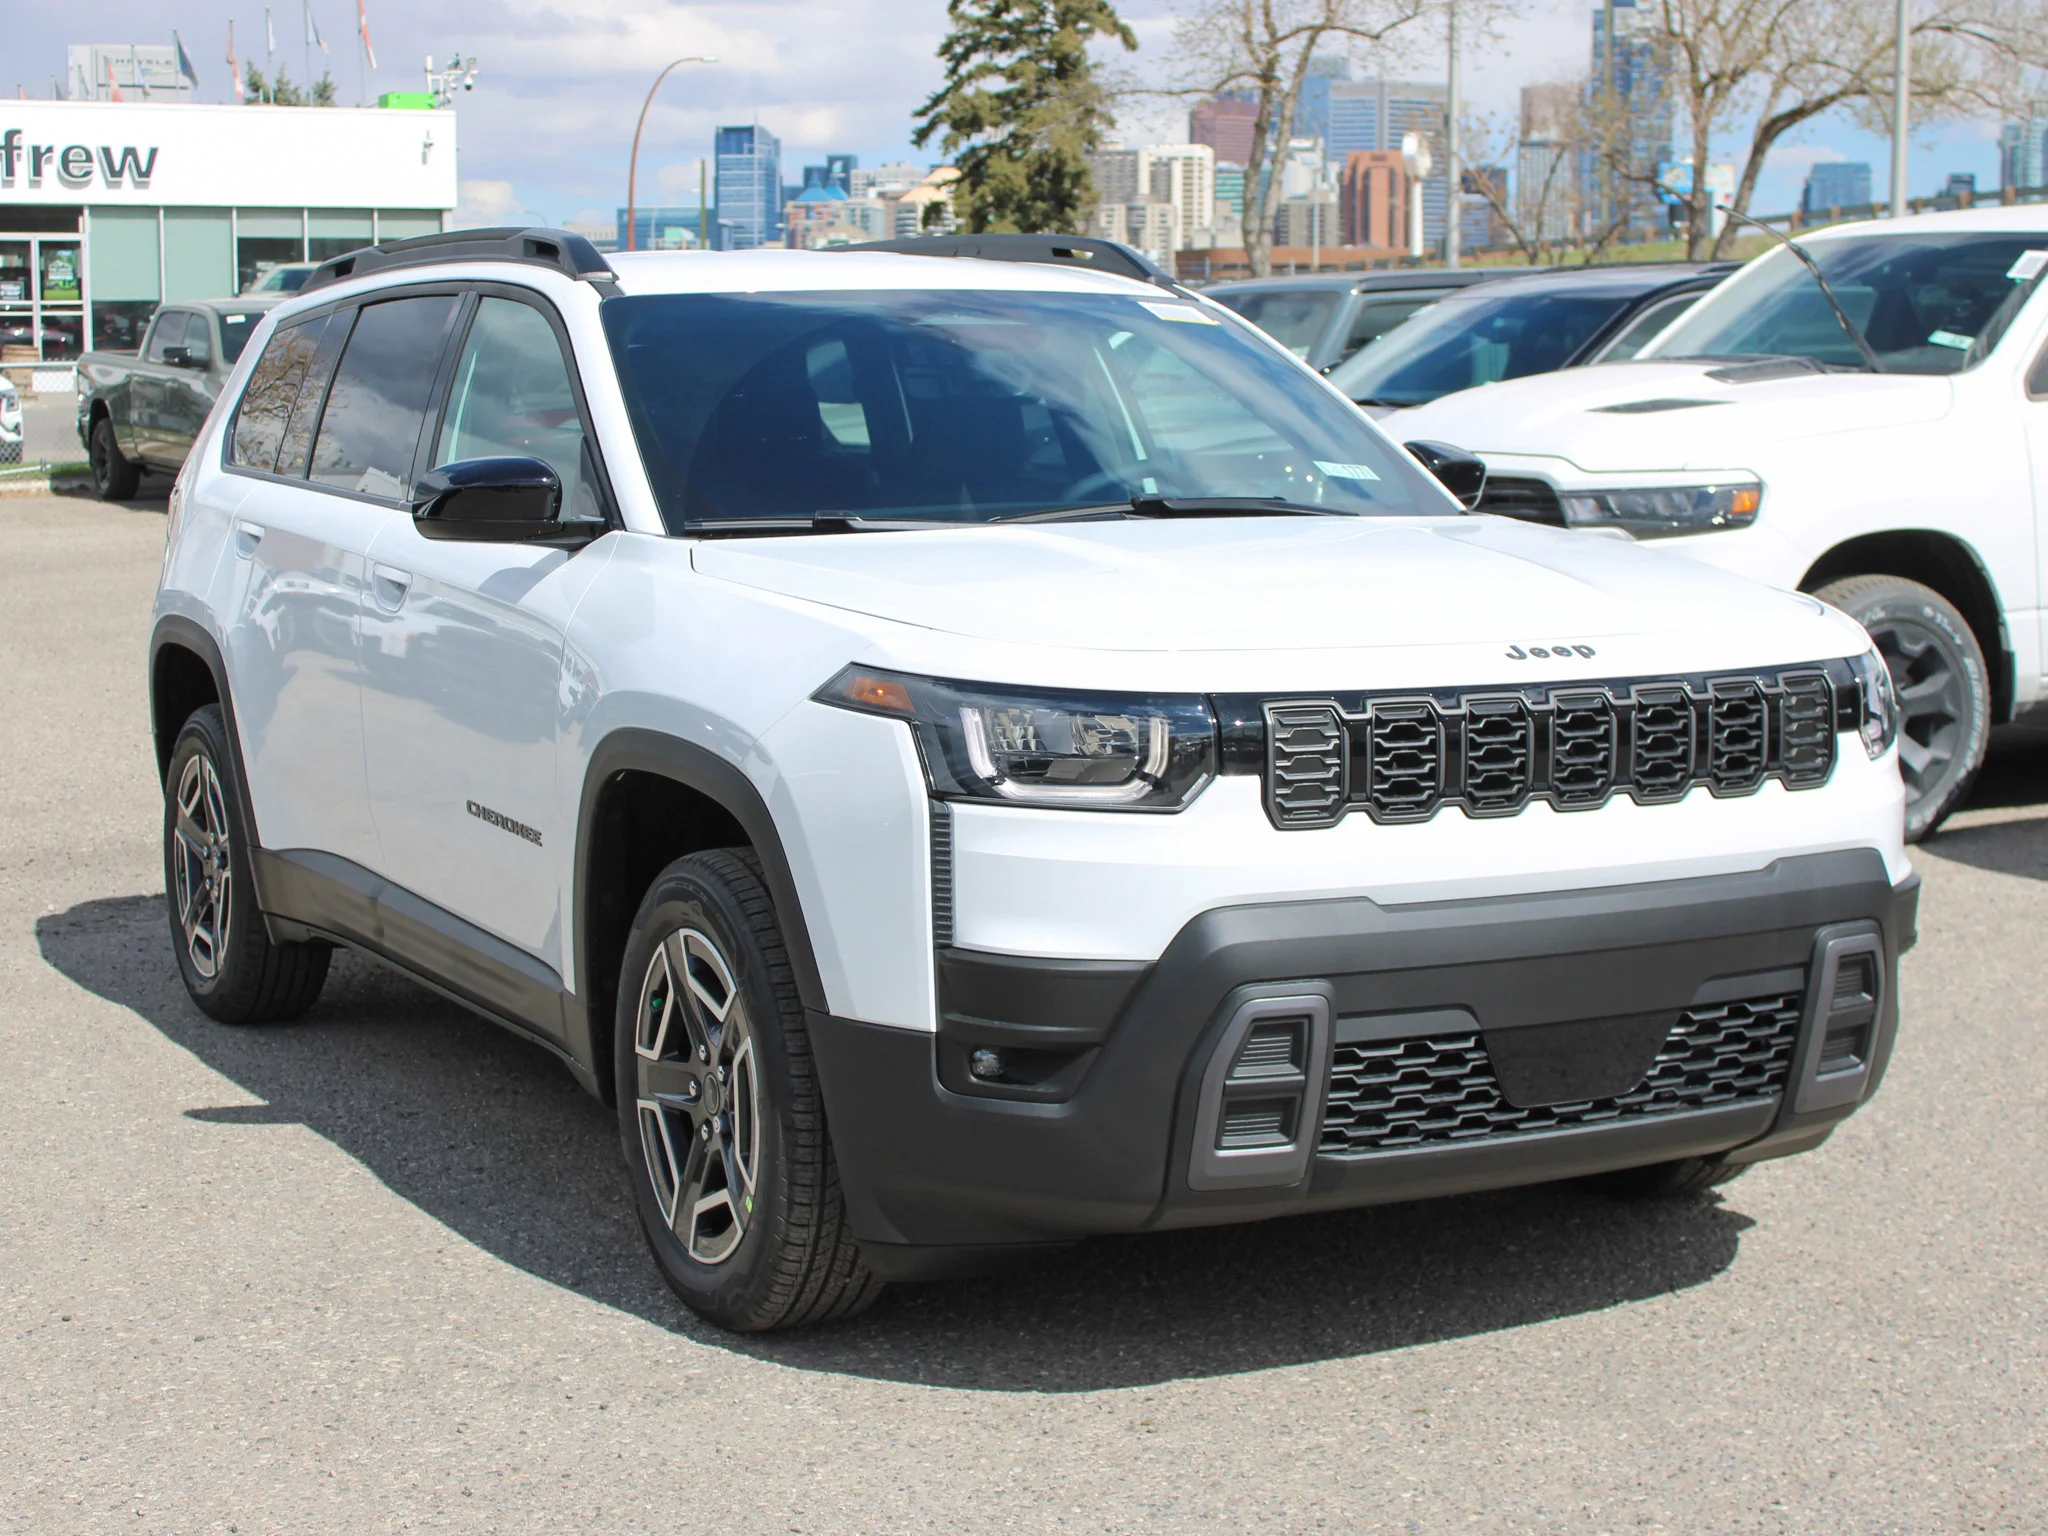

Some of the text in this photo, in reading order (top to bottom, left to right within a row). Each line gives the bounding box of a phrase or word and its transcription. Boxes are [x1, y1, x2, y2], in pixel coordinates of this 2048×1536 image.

[0, 129, 158, 184] frew
[1504, 644, 1597, 661] Jeep
[466, 799, 543, 848] CHEROKEE
